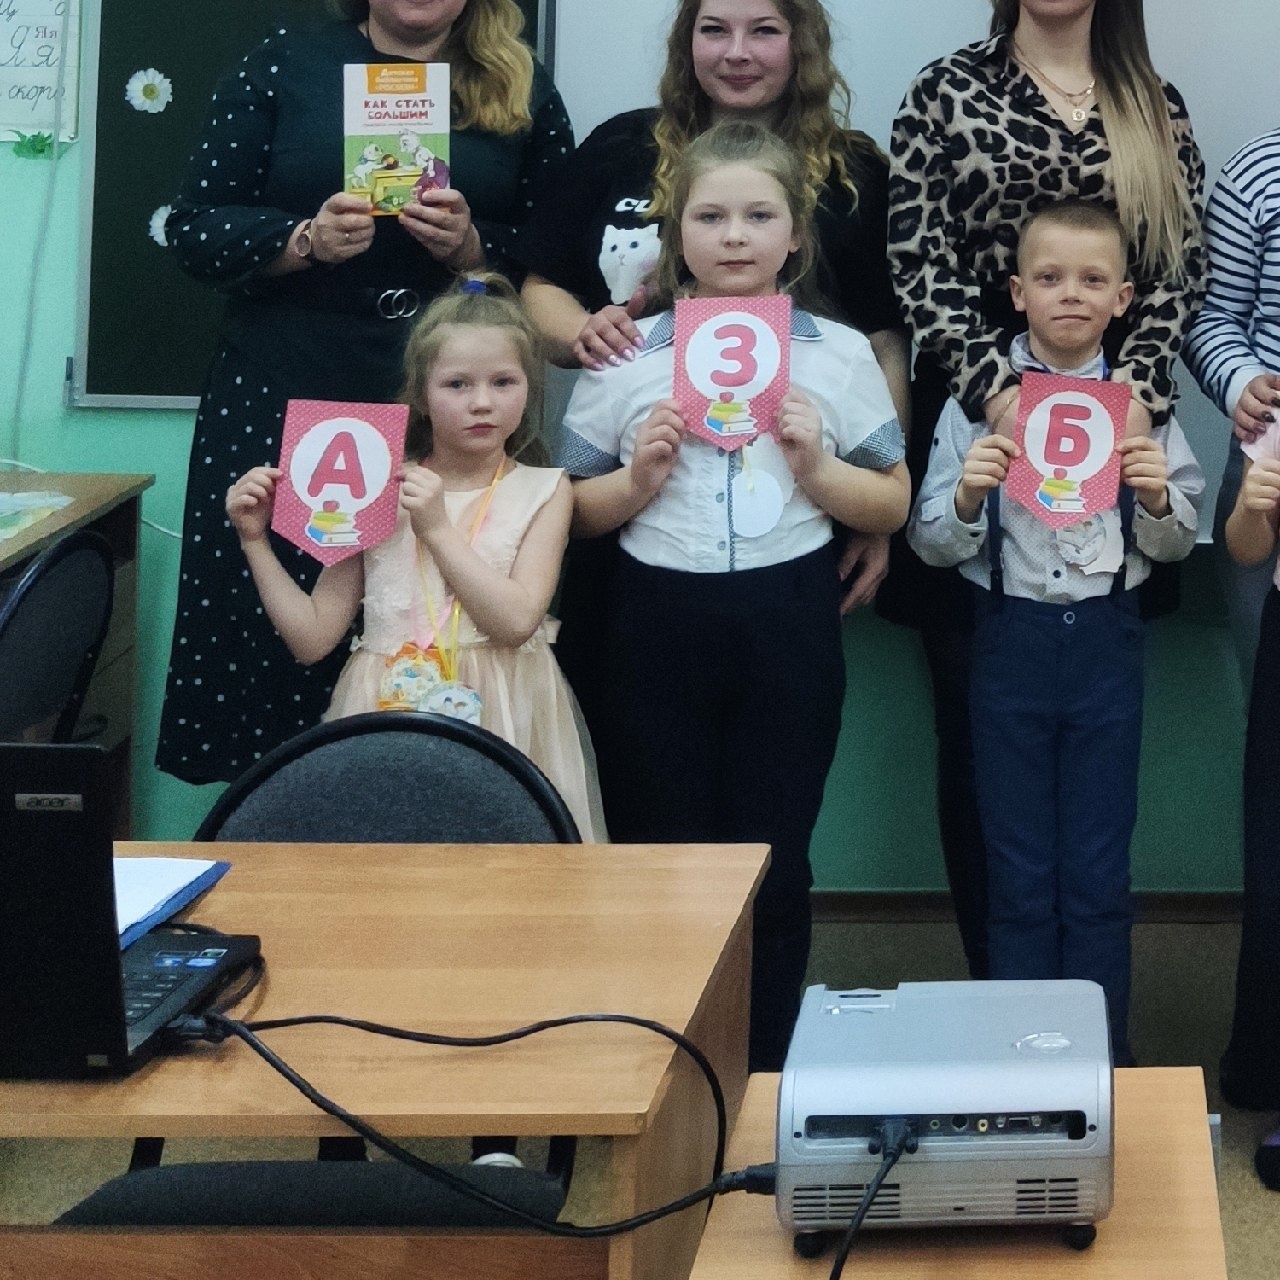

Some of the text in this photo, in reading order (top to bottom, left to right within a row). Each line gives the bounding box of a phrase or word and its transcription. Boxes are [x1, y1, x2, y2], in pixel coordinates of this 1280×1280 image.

[363, 98, 436, 109] КАК СТАТЬ
[367, 110, 429, 120] БОЛЬШИМ
[1043, 403, 1092, 467] Б
[306, 430, 367, 500] А
